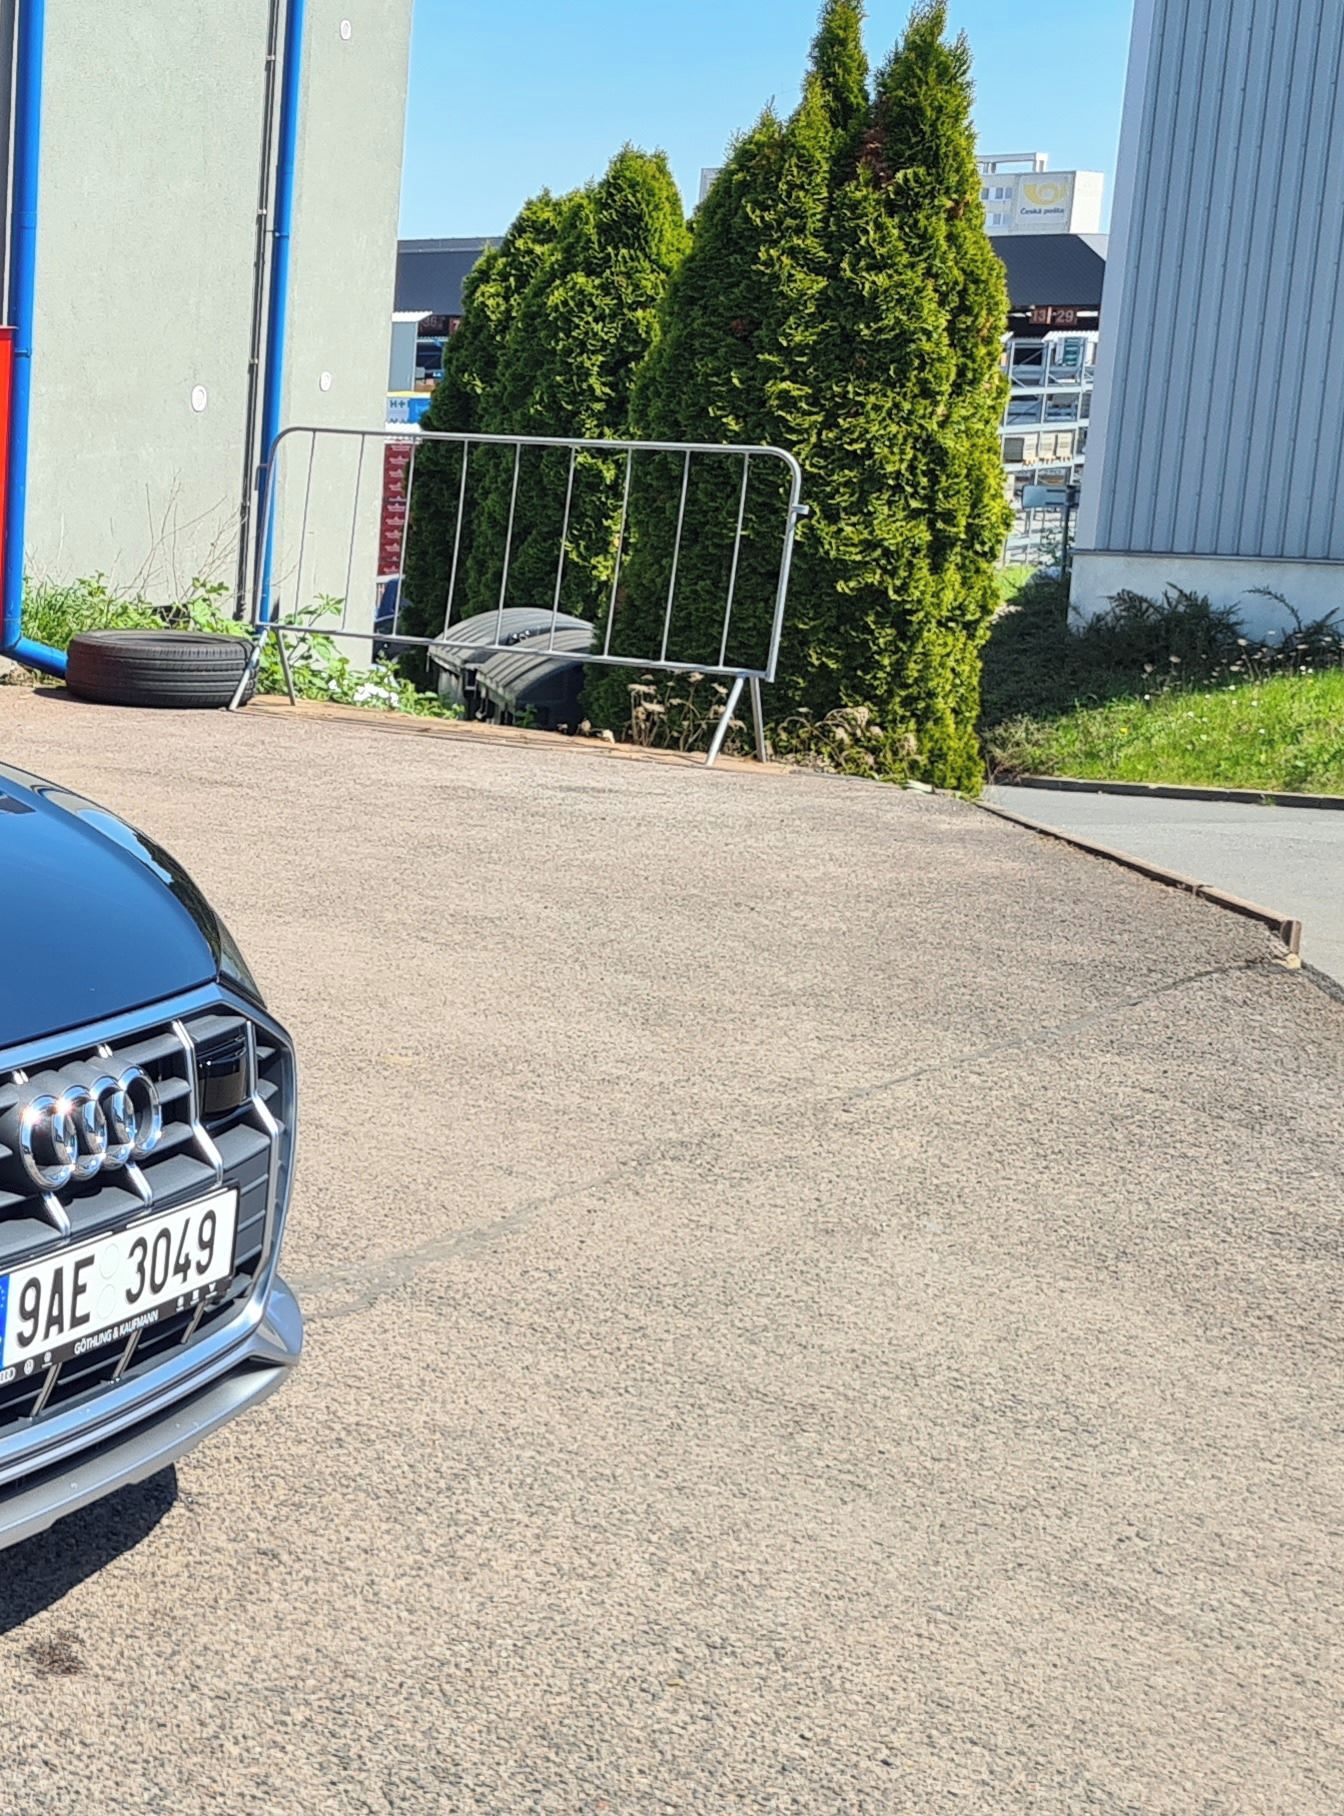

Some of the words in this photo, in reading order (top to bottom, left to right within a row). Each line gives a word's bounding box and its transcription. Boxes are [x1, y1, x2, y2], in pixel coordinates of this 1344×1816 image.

[16, 1253, 96, 1349] 9AE
[124, 1208, 218, 1305] 3049
[73, 1327, 112, 1355] GÖTHLING
[119, 1309, 160, 1337] KAUFMANN
